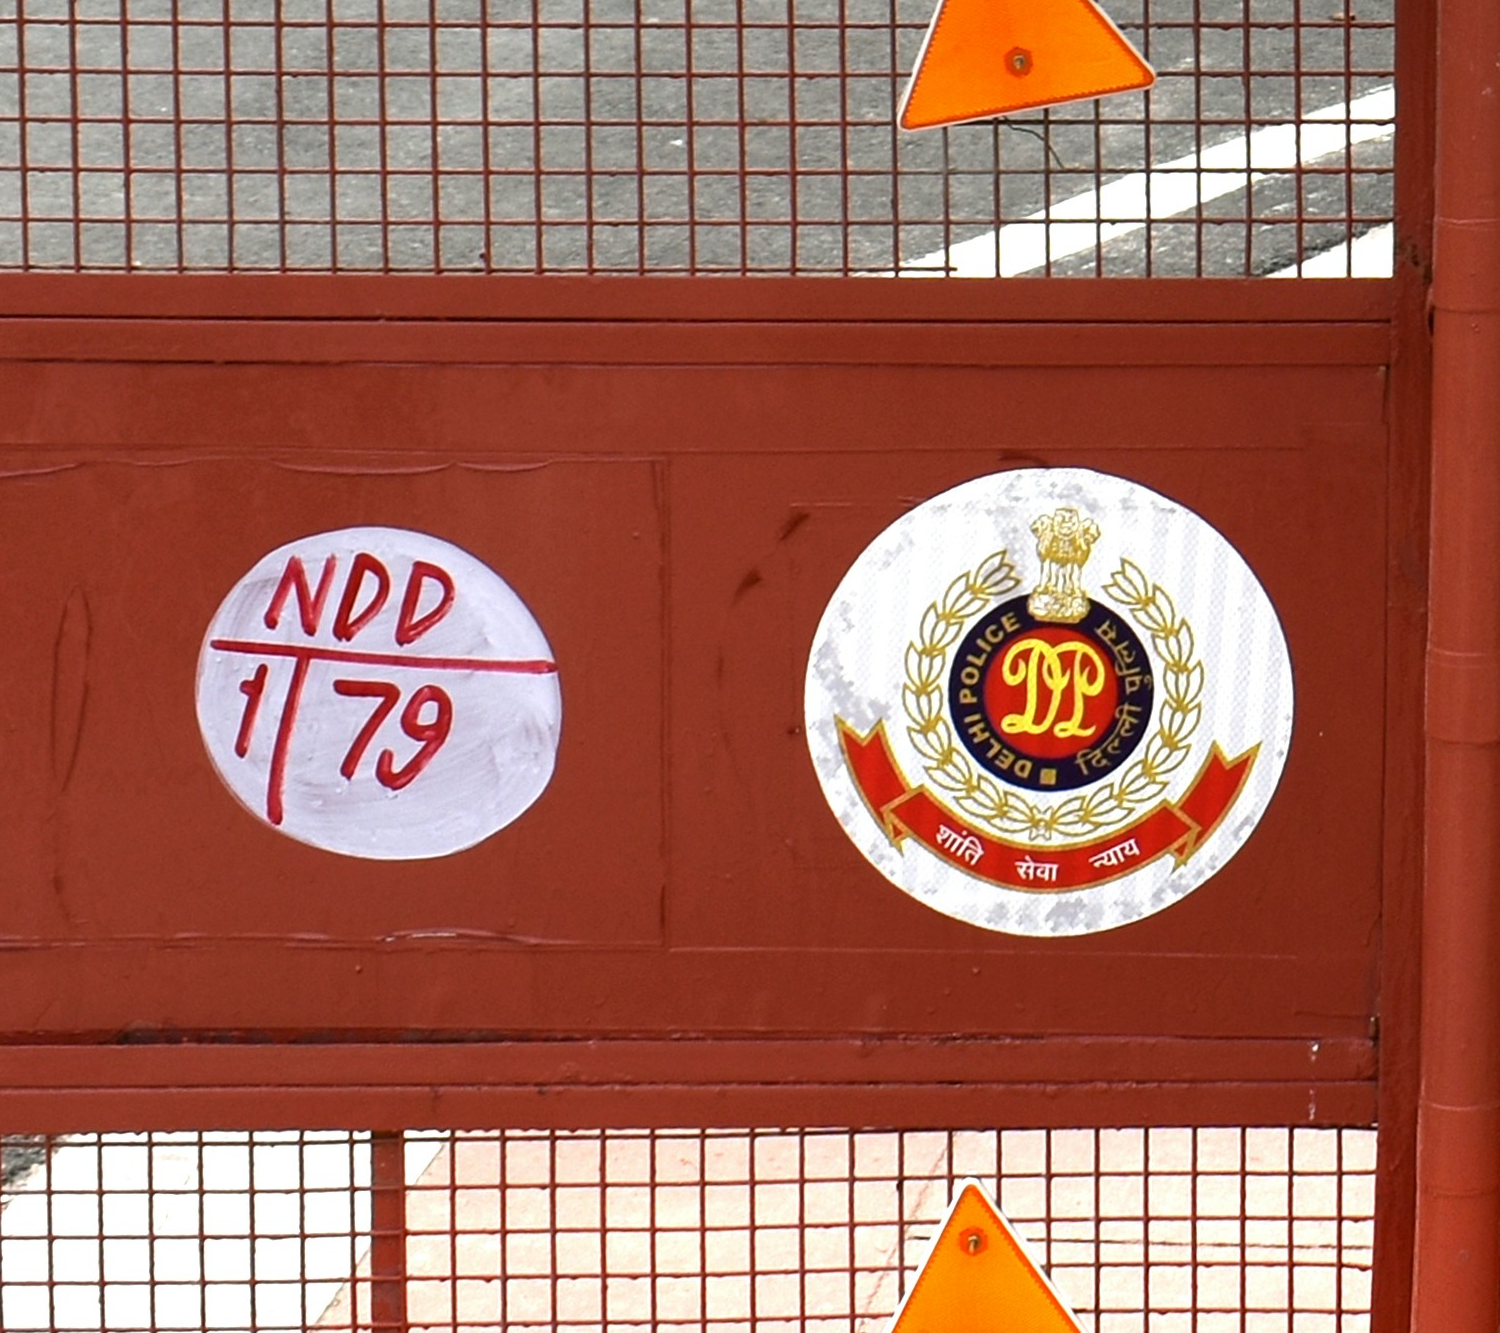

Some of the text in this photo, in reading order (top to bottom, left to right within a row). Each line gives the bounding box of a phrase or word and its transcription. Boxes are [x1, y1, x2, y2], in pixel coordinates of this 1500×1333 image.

[263, 552, 456, 646] NDD
[959, 611, 1034, 779] DELHI POLICE
[1094, 620, 1153, 695] पुलिस
[934, 824, 1141, 882] शांति सेवा न्याय
